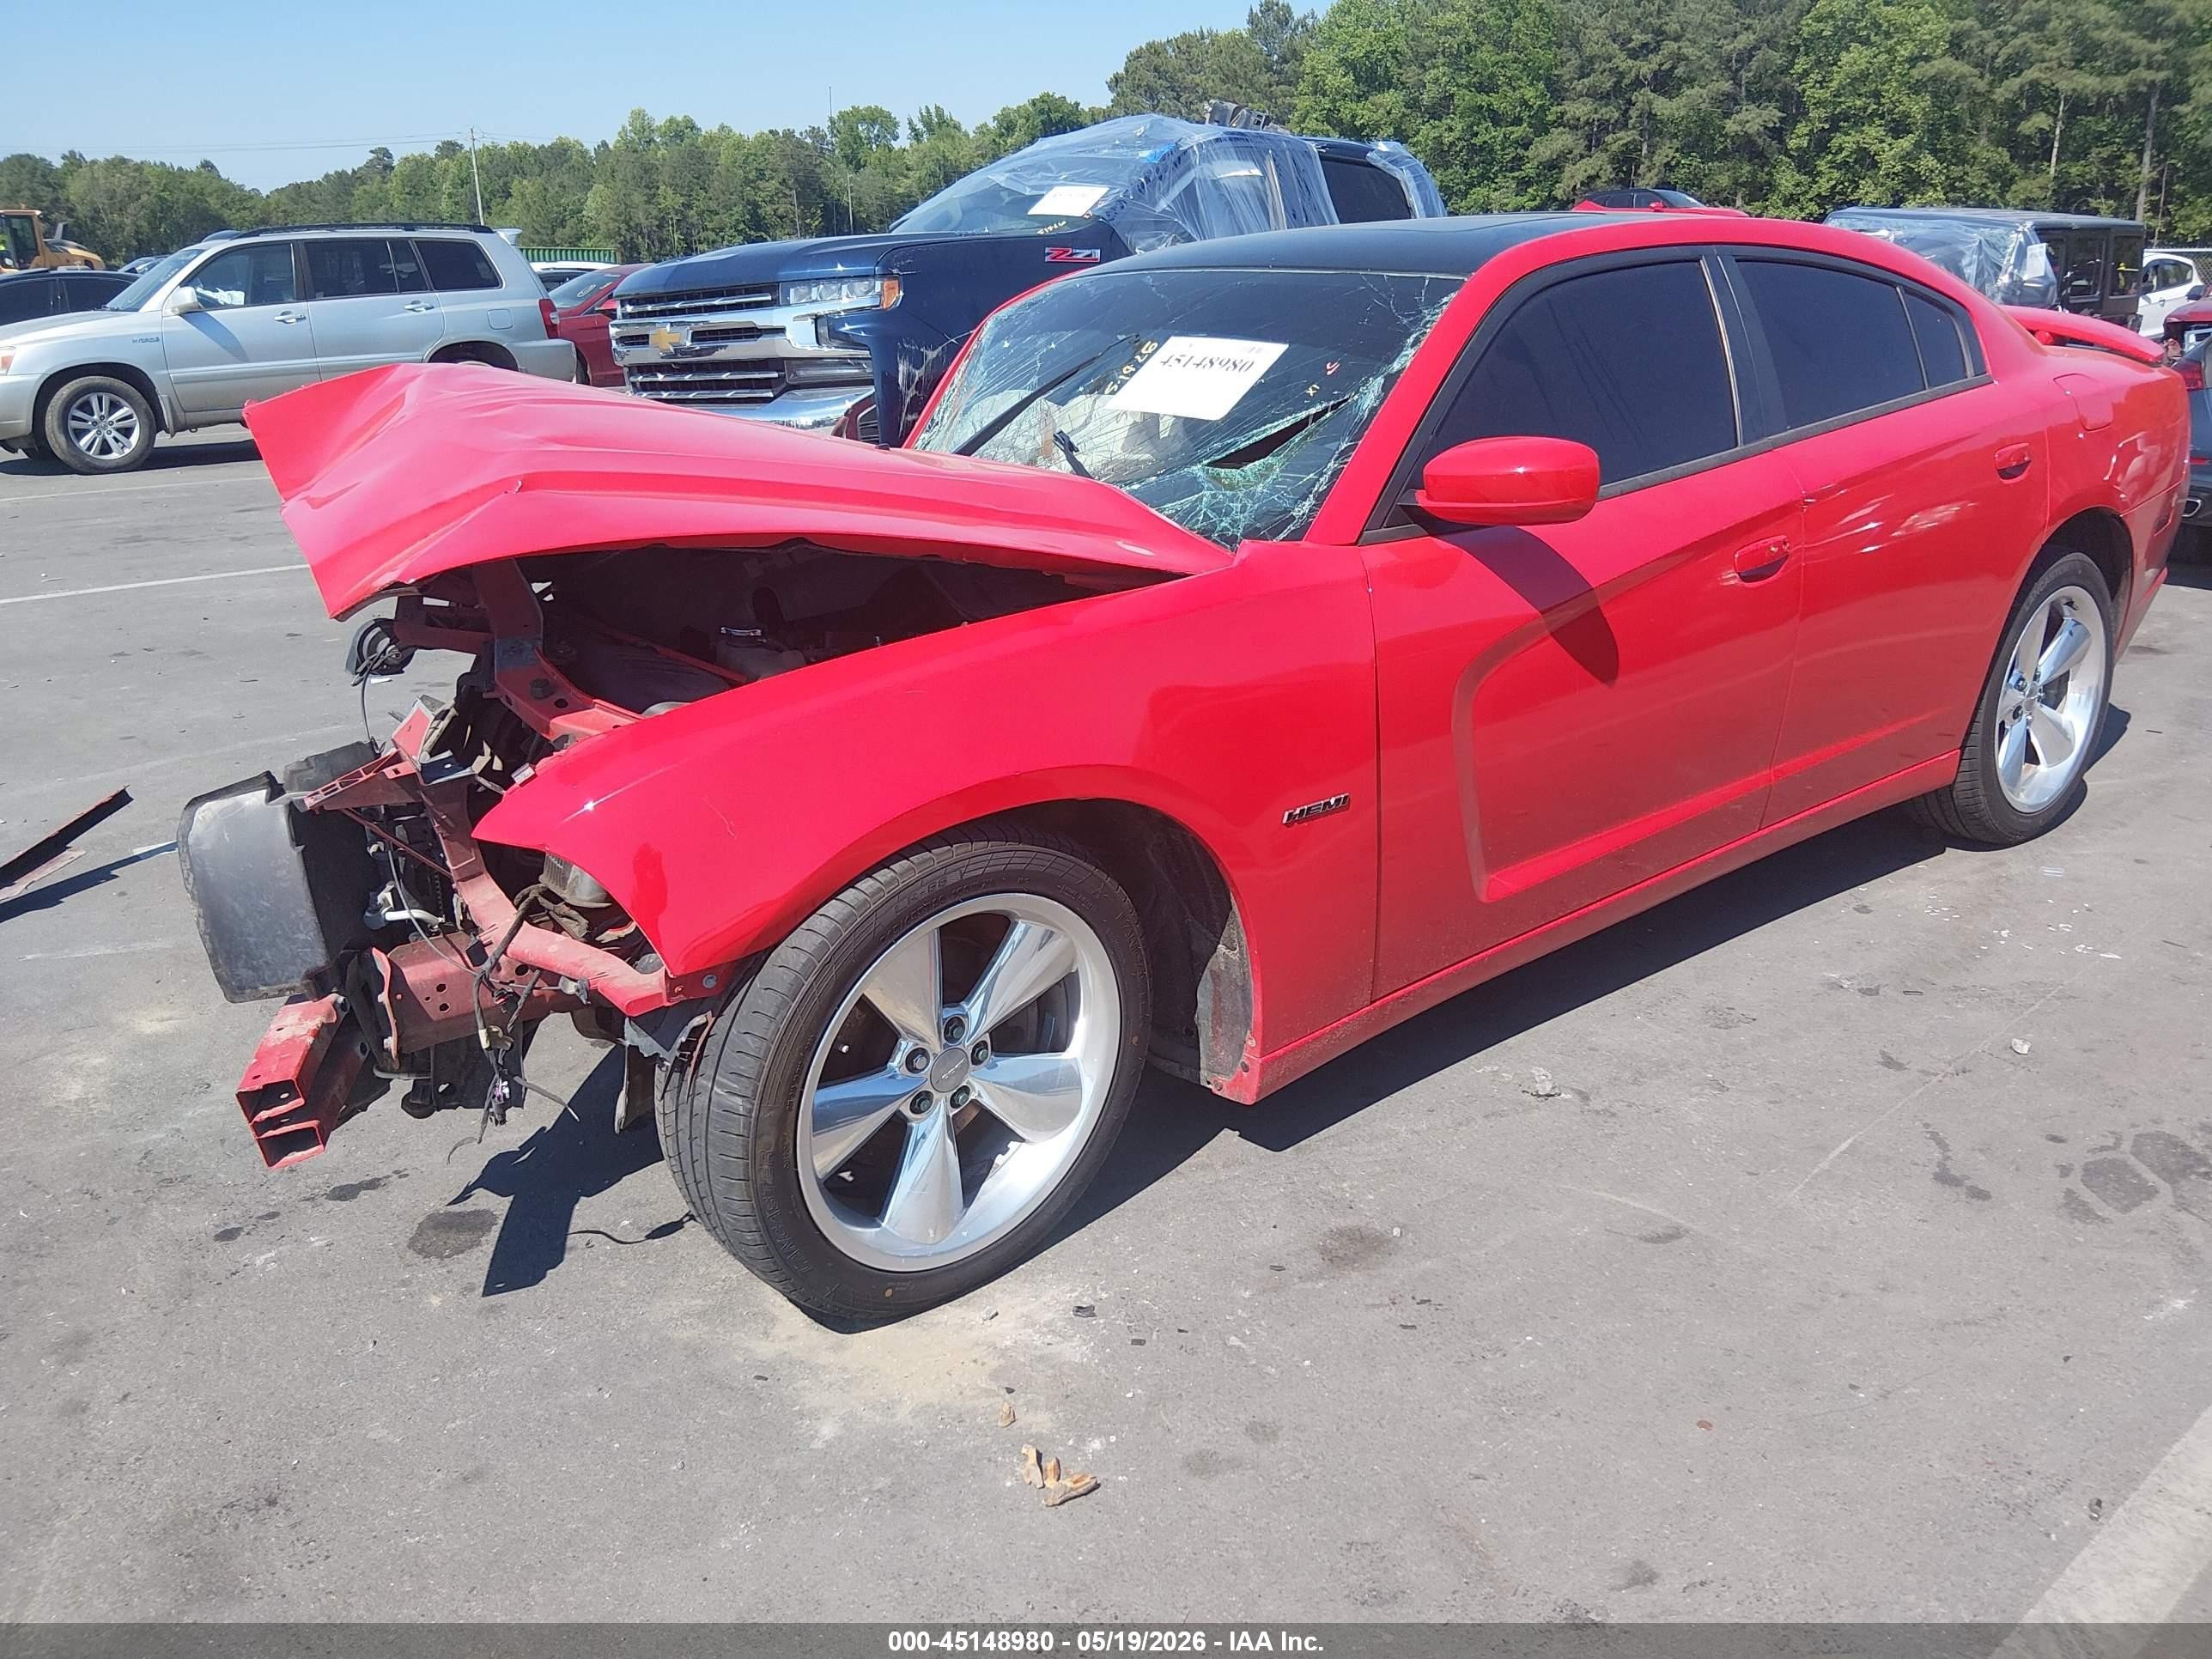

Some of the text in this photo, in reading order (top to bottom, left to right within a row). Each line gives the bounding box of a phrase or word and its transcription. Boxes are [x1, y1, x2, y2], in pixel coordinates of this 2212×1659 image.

[1044, 247, 1101, 263] Z71
[1160, 354, 1255, 374] 45148980
[1282, 793, 1349, 823] HEMI
